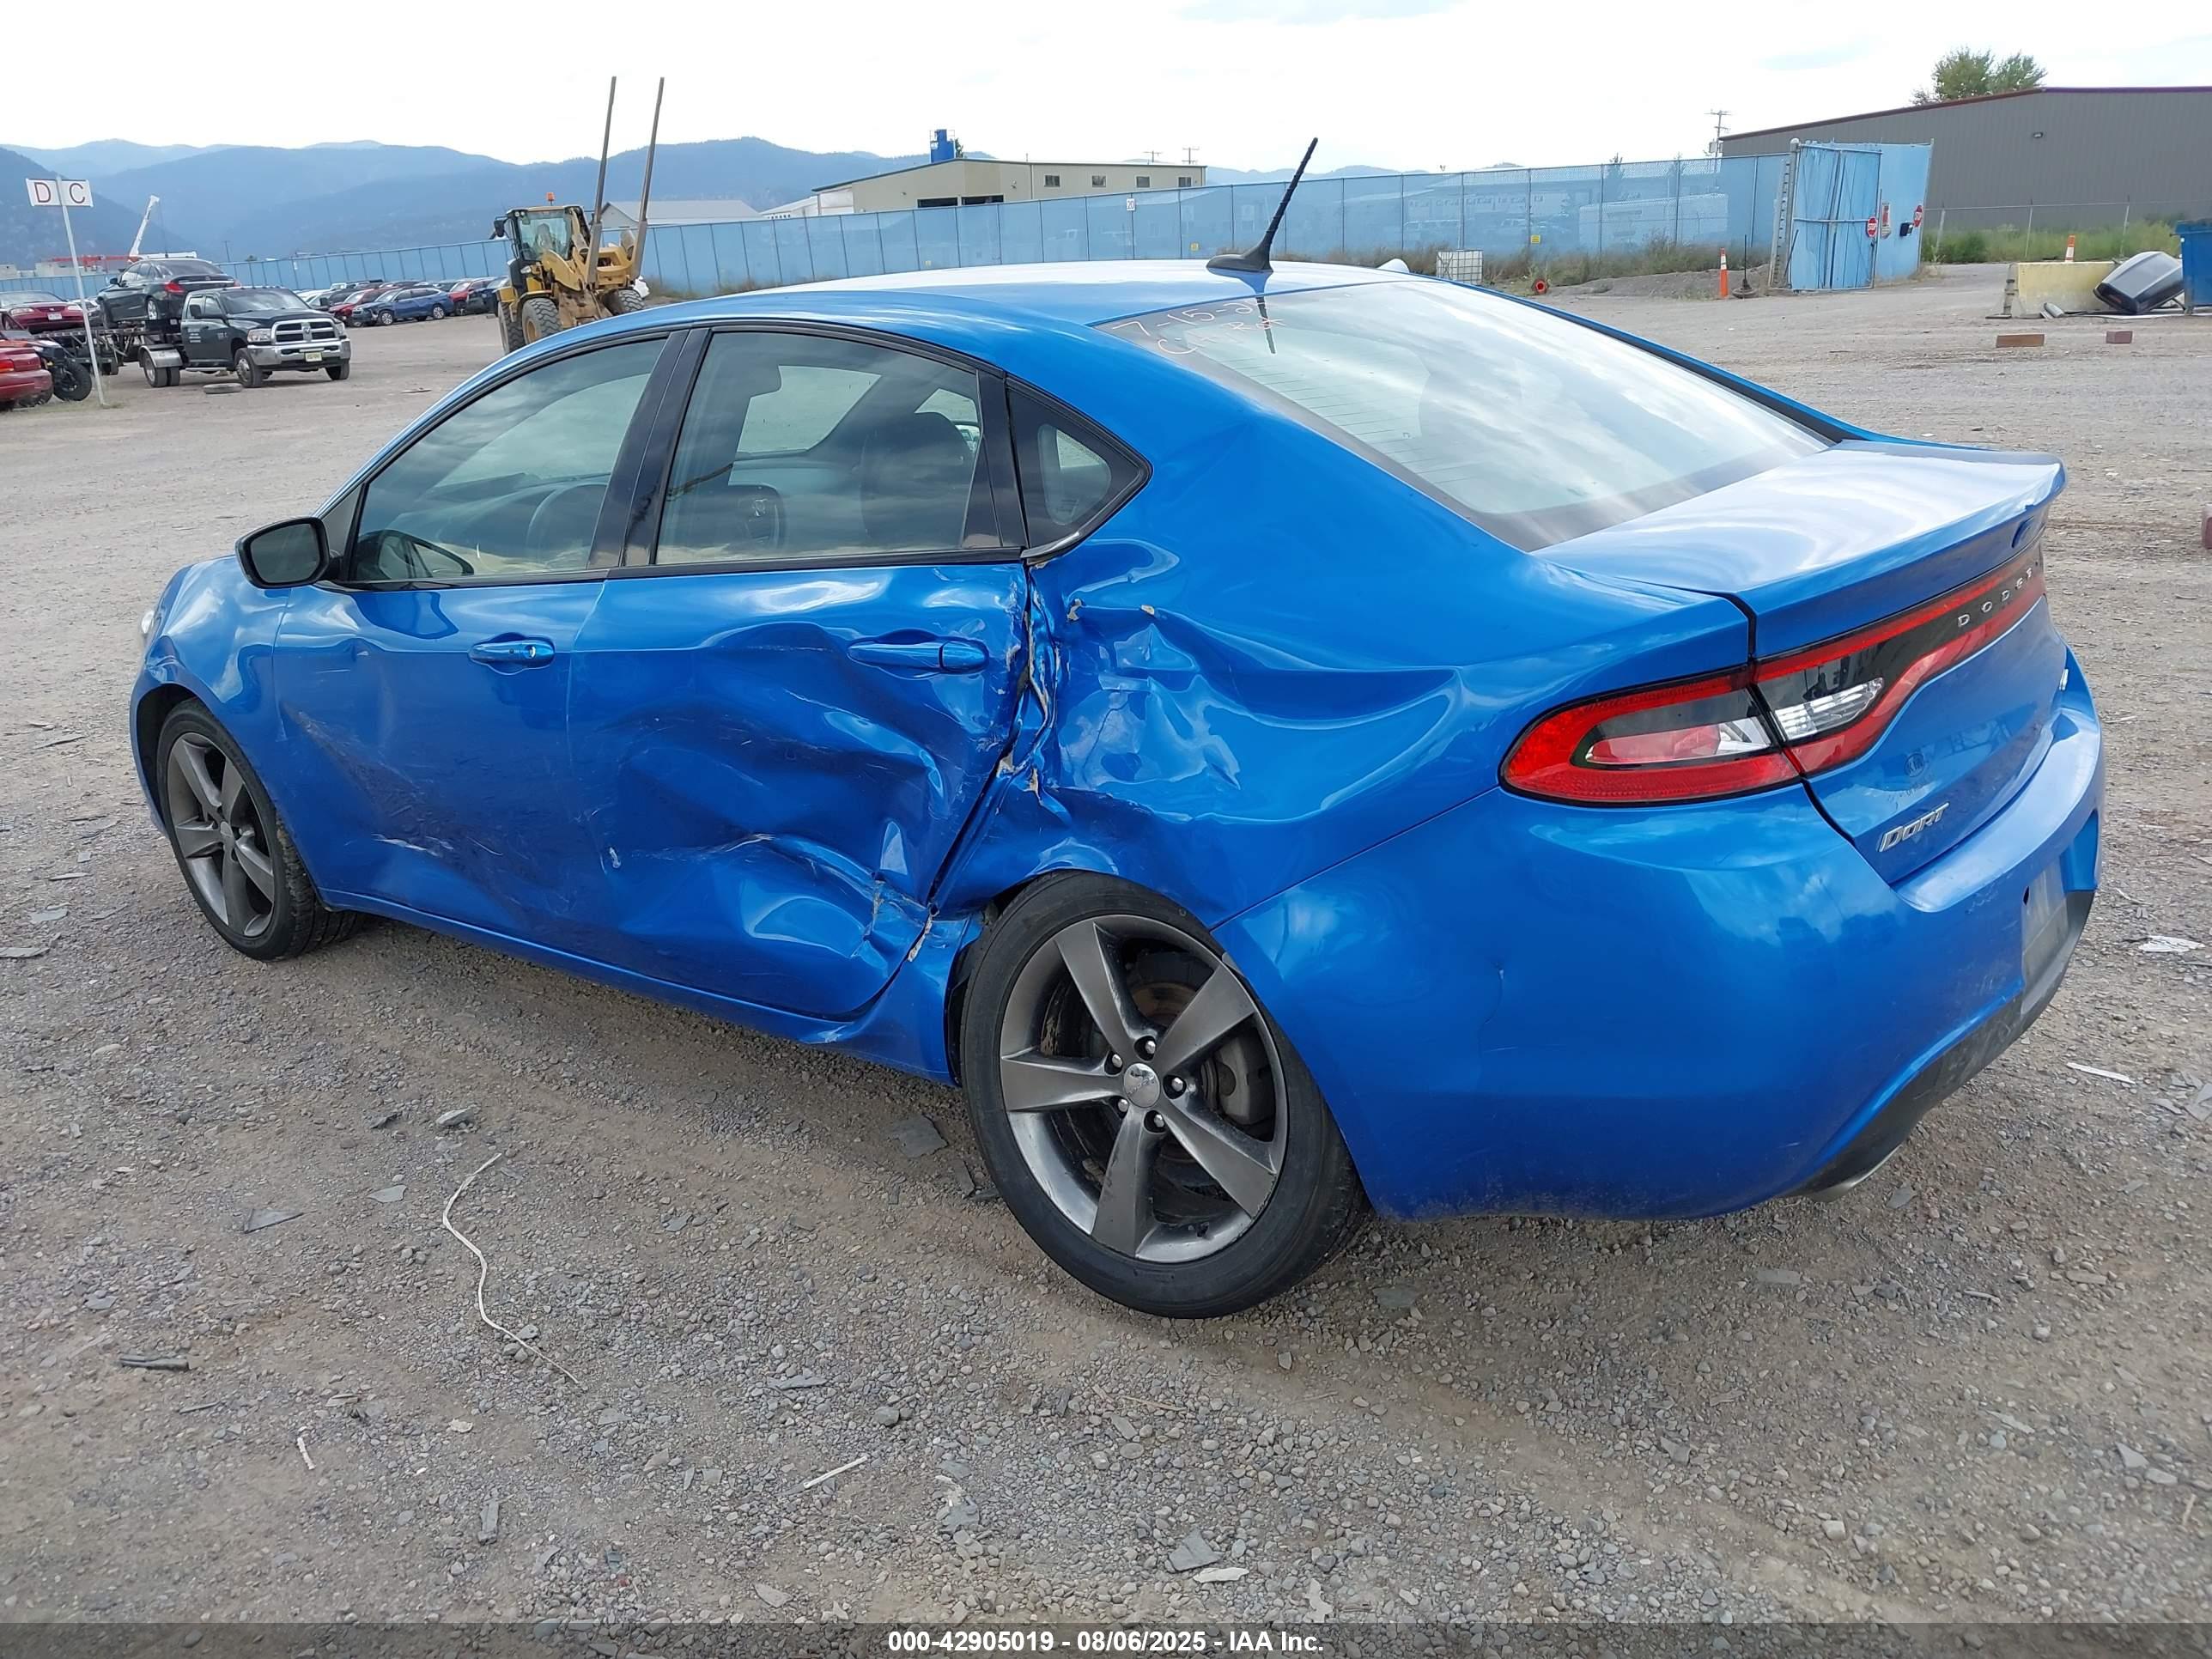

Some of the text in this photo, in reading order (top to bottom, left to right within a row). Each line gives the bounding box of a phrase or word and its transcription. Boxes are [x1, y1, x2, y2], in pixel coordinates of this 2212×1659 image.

[34, 182, 85, 204] D C
[1879, 802, 1949, 853] DART
